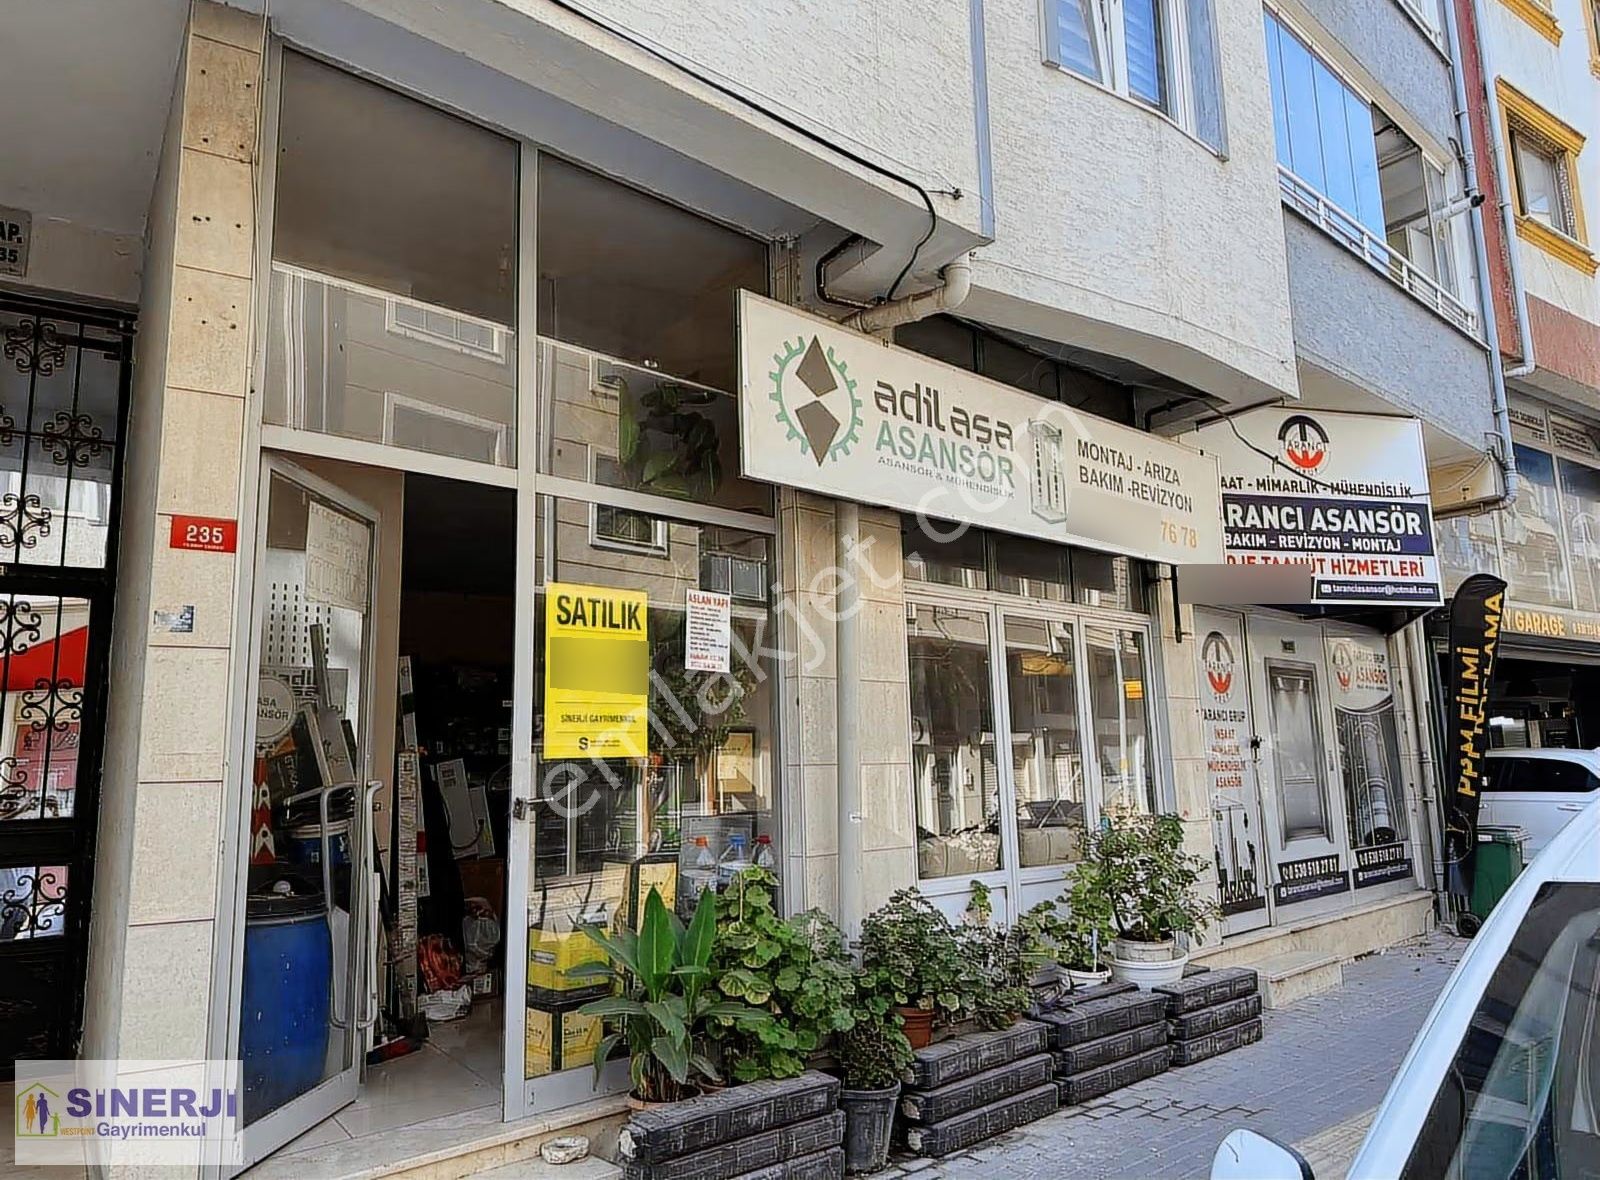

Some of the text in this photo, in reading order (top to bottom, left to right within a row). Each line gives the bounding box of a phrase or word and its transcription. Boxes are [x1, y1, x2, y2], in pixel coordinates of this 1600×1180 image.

[875, 420, 1016, 488] ASANSÖR
[1077, 438, 1133, 471] MONTAJ
[1144, 460, 1180, 486] ARIZA
[1079, 465, 1123, 493] BAKIM
[186, 525, 223, 543] 235
[1161, 521, 1197, 548] 76 78
[1310, 505, 1423, 536] ASANSÖR
[1225, 532, 1266, 547] BAKIM
[1279, 532, 1340, 550] REVİZYON
[1352, 538, 1401, 553] MONTAJ
[1331, 554, 1425, 577] HİZMETLERİ
[556, 595, 642, 630] SATILIK
[1515, 610, 1566, 636] GARAGE
[1456, 646, 1480, 721] FİLMİ
